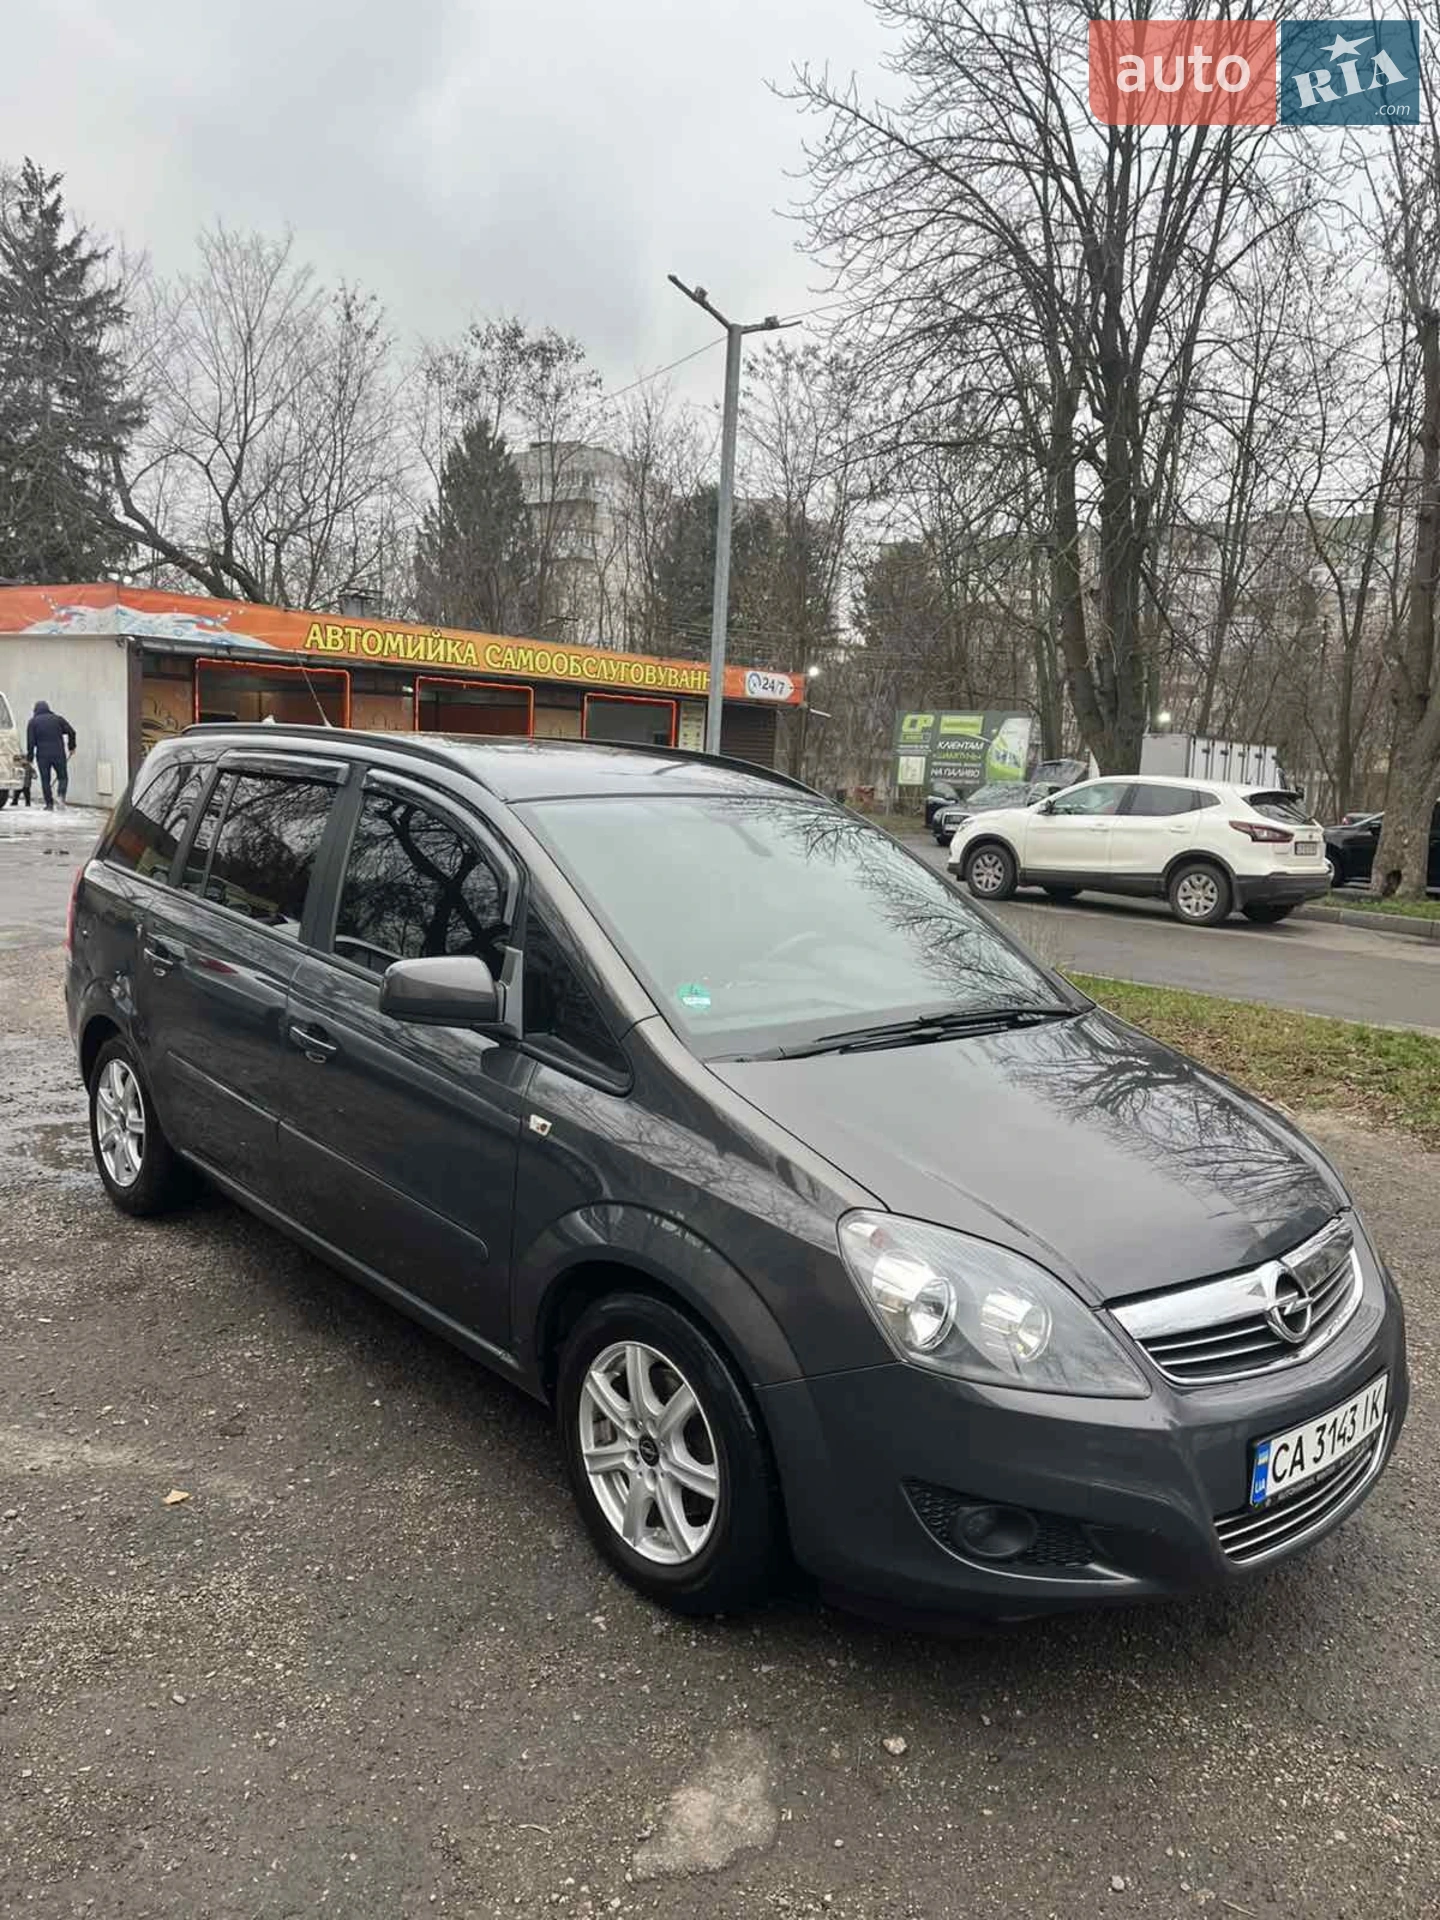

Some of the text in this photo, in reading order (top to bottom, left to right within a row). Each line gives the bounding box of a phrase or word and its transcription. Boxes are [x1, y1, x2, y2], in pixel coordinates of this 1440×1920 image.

[304, 622, 711, 691] АВТОМИЙКА САМООБСЛУГОВУВАНН
[761, 676, 786, 693] 24/7
[1272, 1434, 1305, 1484] CA
[1312, 1404, 1358, 1464] 3143
[1362, 1383, 1384, 1430] IK
